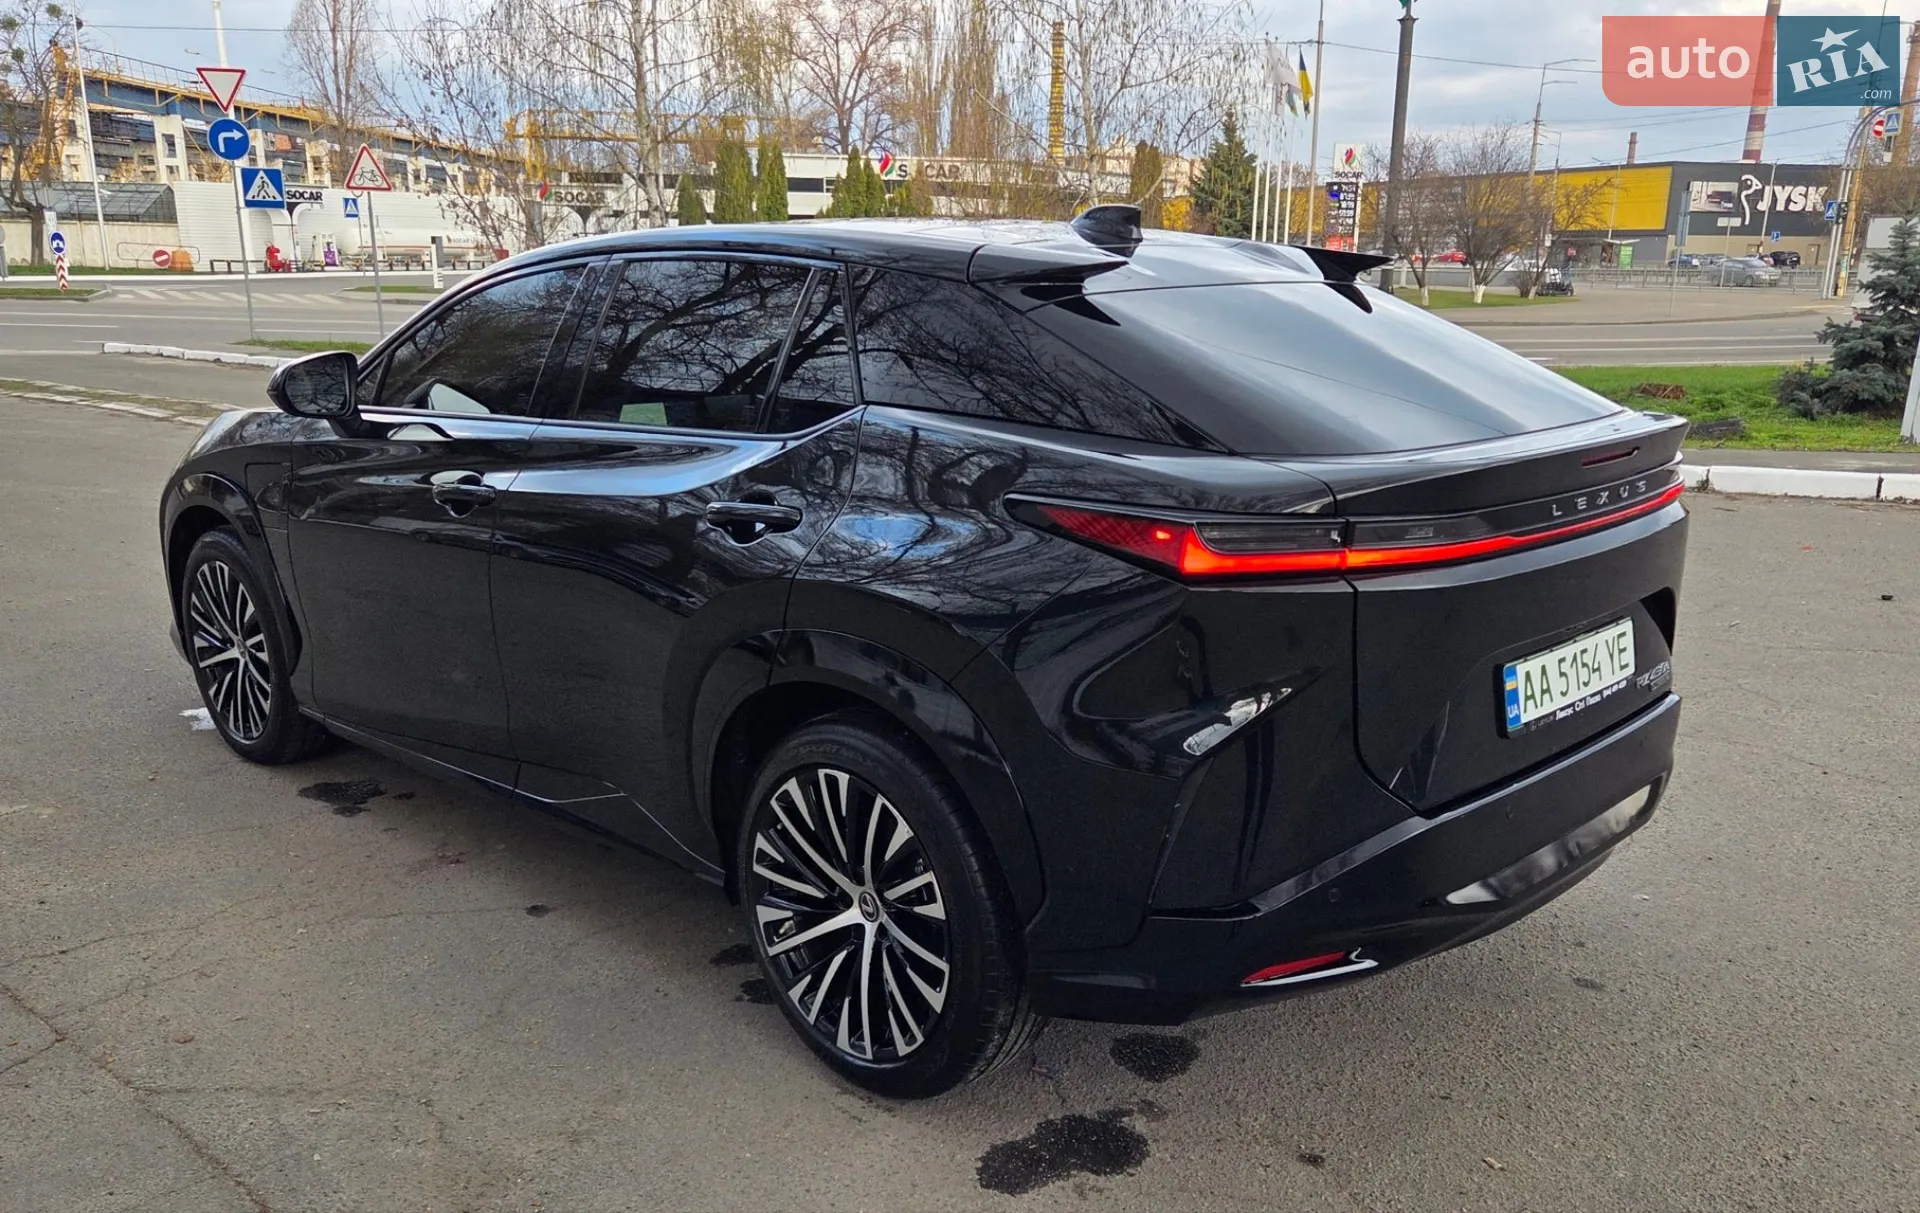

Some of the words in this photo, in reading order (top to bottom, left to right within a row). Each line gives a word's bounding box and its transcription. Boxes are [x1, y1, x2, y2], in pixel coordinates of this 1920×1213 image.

[897, 162, 961, 180] SCAR
[286, 189, 323, 201] SOCAR
[554, 190, 606, 204] SOCAR
[1756, 185, 1828, 212] JYSK
[1552, 480, 1646, 516] LEXUS
[1523, 664, 1554, 714] AA
[1557, 643, 1602, 697] 5154
[1605, 631, 1630, 676] YE
[1507, 703, 1520, 719] UA
